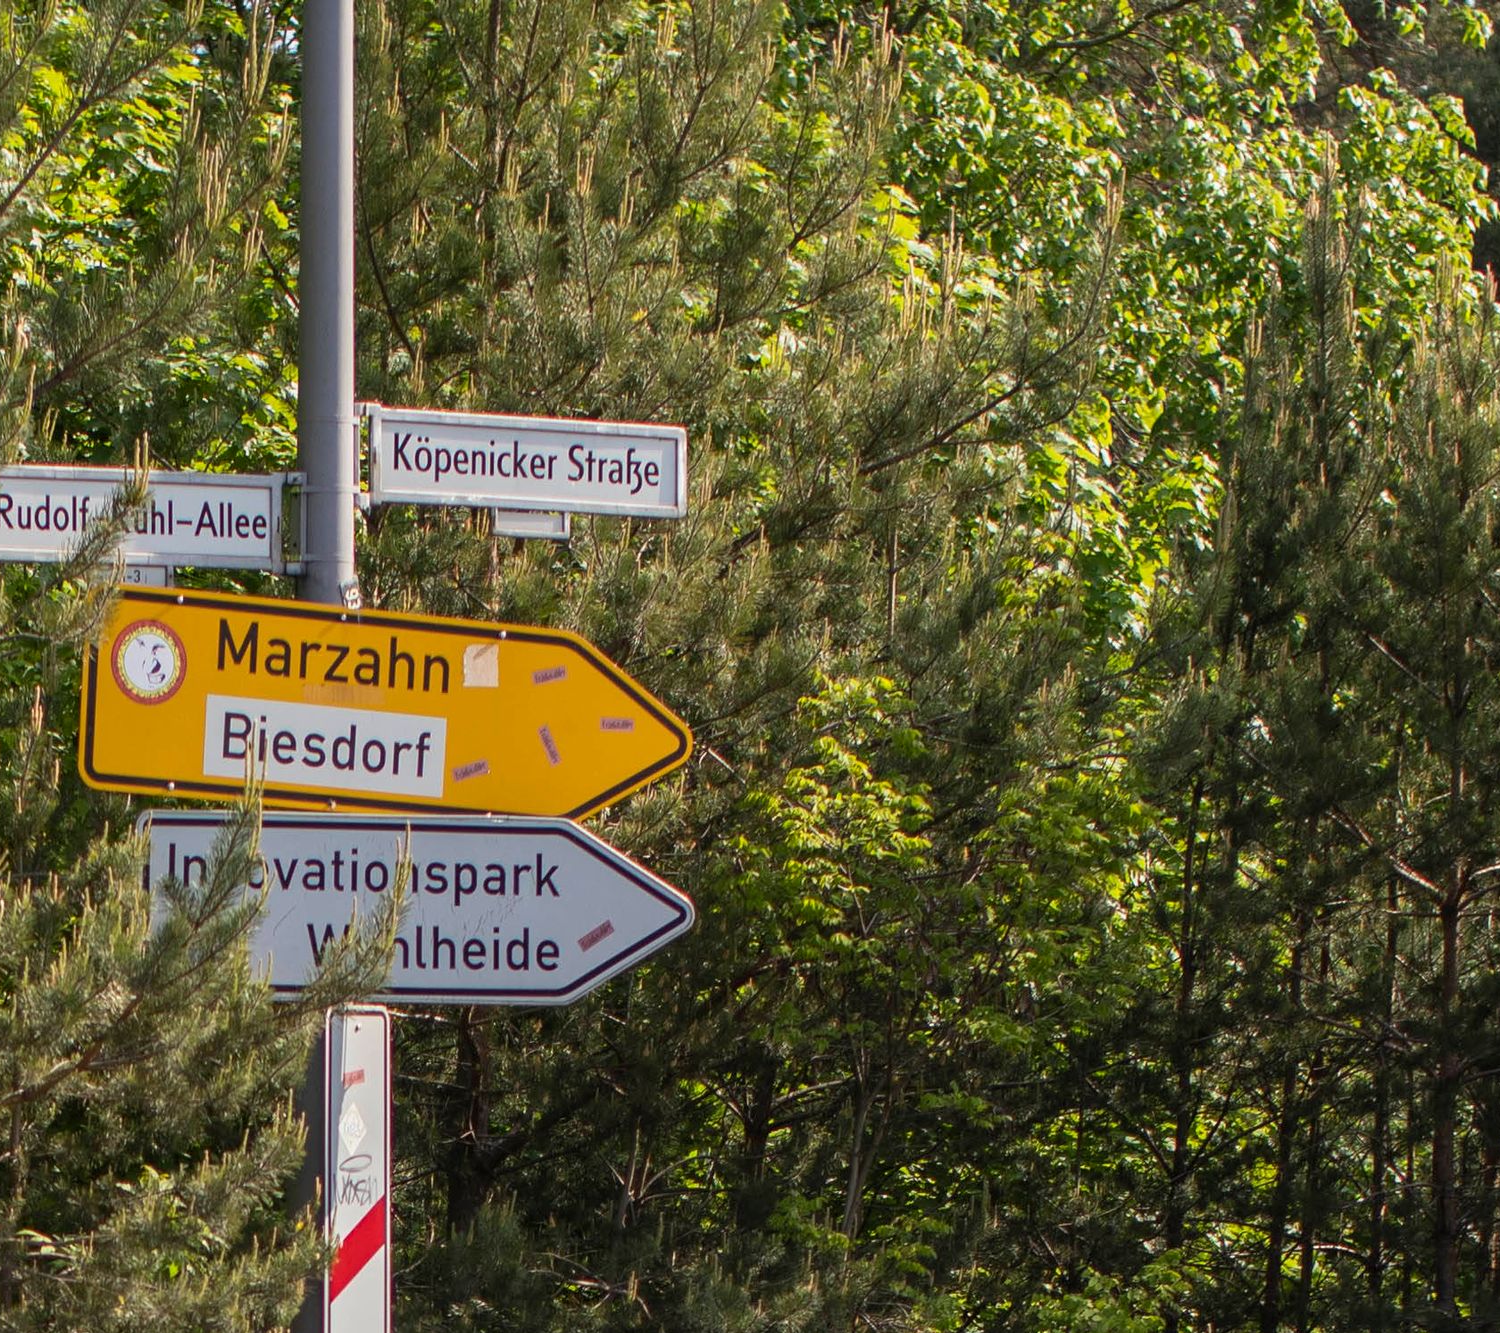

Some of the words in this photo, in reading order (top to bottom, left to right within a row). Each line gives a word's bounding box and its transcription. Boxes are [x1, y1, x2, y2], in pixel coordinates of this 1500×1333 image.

[393, 433, 558, 482] Köpenicker
[567, 444, 660, 495] Straße
[217, 618, 450, 694] Marzahn
[221, 711, 432, 778] Biesdorf
[168, 842, 561, 907] Inovatiospark
[306, 923, 561, 972] Wlheide
